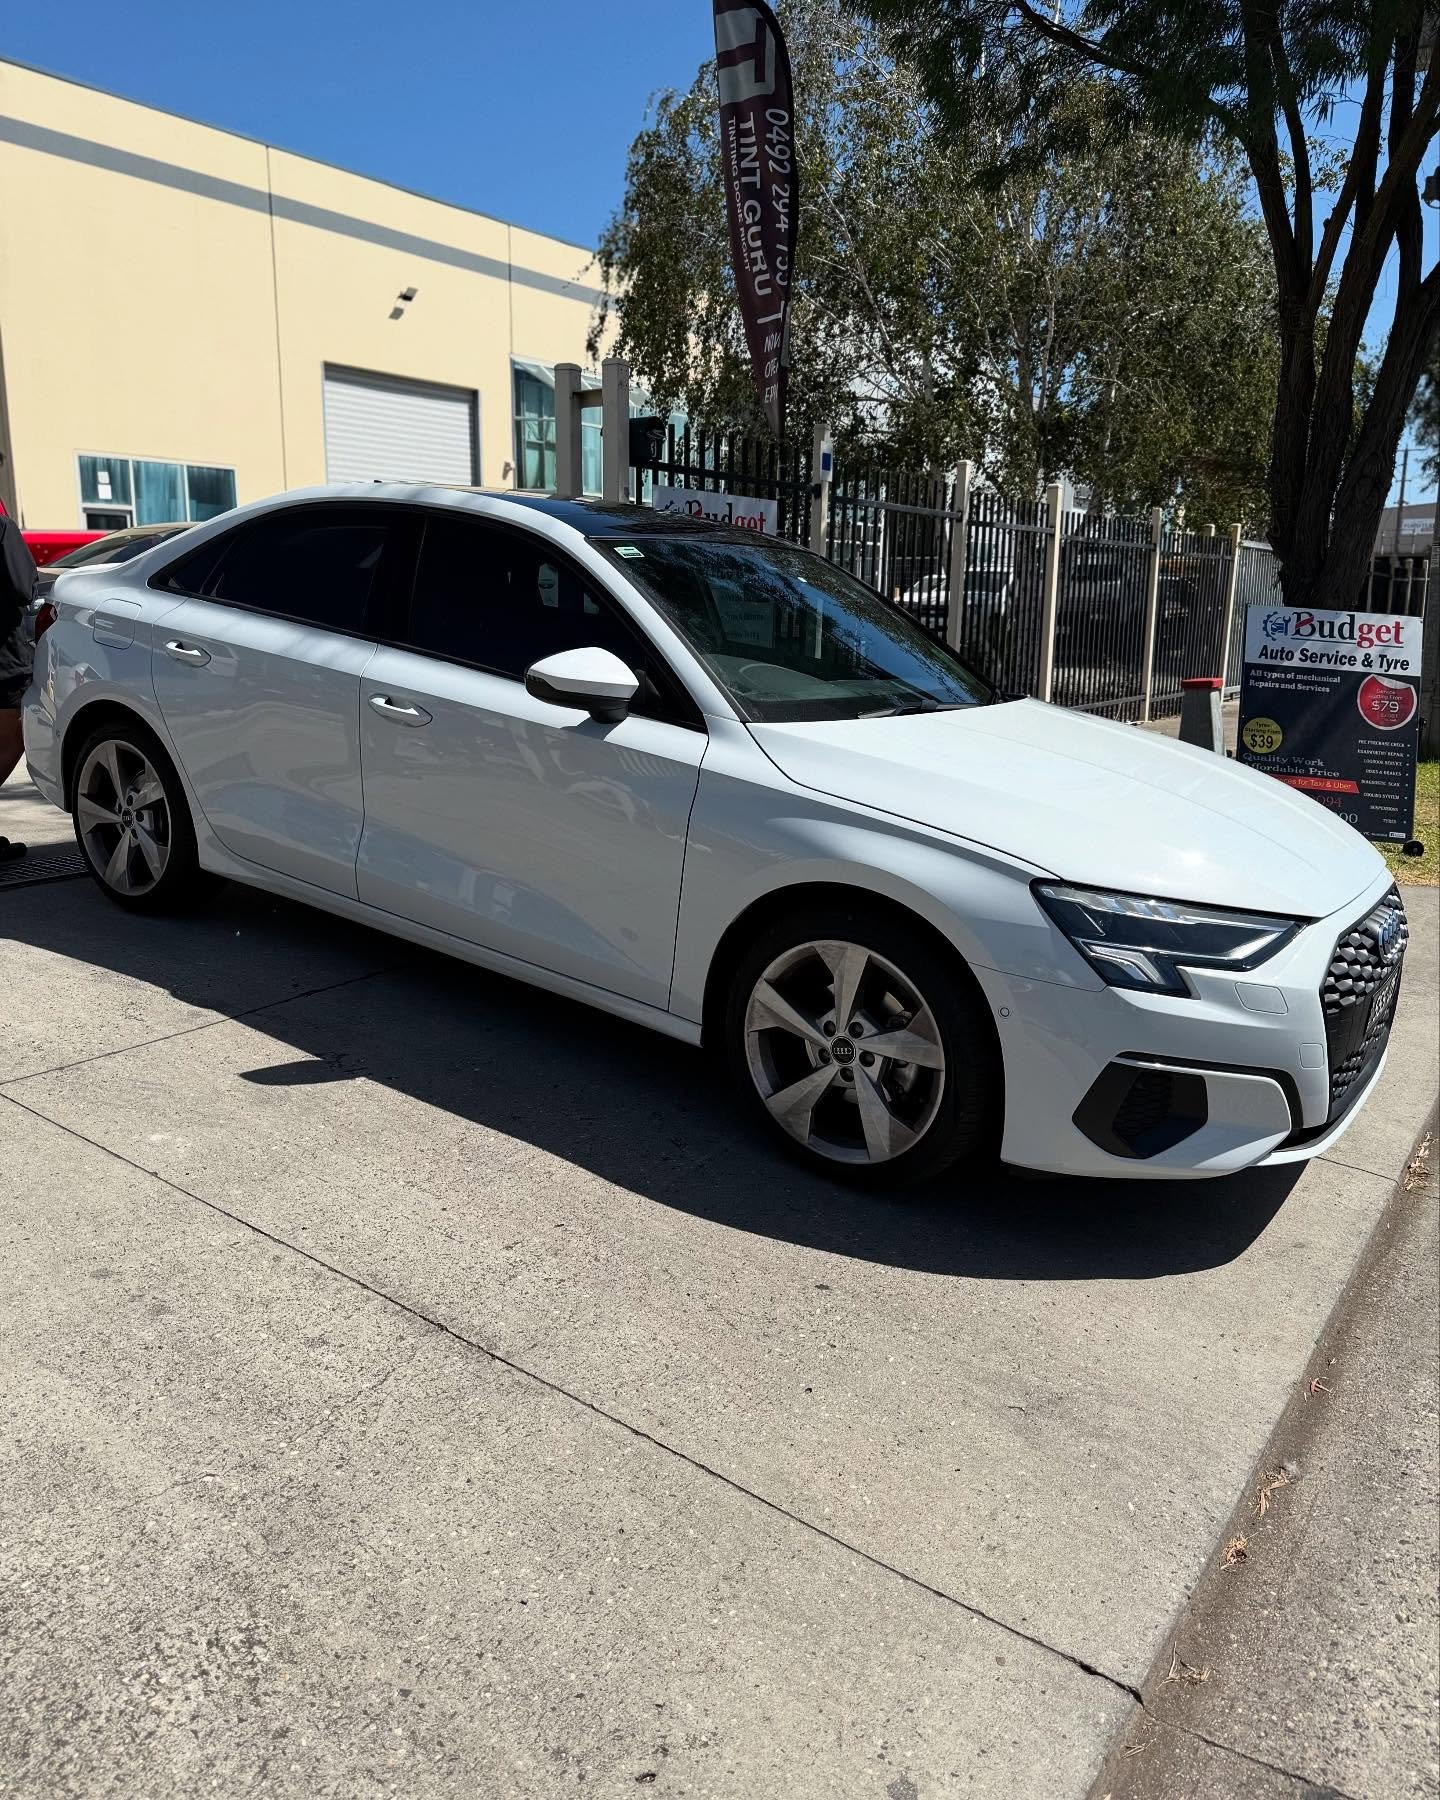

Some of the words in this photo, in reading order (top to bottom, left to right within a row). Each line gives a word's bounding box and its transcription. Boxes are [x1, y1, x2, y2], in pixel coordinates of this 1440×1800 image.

[765, 108, 791, 174] 0492
[739, 112, 761, 189] TINT
[728, 116, 738, 177] TINTING
[733, 183, 744, 223] DONE
[739, 227, 751, 272] RIGHT
[743, 199, 772, 296] GURU
[1291, 611, 1405, 649] Budget
[1258, 644, 1295, 662] Auto
[1298, 648, 1357, 667] Service
[1361, 652, 1373, 668] &
[1378, 654, 1410, 672] Tyre
[1249, 669, 1263, 677] All
[1263, 671, 1286, 679] types
[1286, 672, 1295, 680] of
[1295, 673, 1341, 684] mechanical
[1249, 679, 1280, 689] Repairs
[1280, 682, 1296, 690] and
[1296, 683, 1331, 693] Services
[1371, 700, 1399, 713] $79
[1250, 733, 1274, 750] $39
[1242, 752, 1289, 765] Quality
[1292, 756, 1325, 767] Work
[1309, 767, 1340, 778] Price
[1311, 780, 1324, 788] Taxi
[1325, 780, 1332, 788] &
[1333, 781, 1352, 789] Uber
